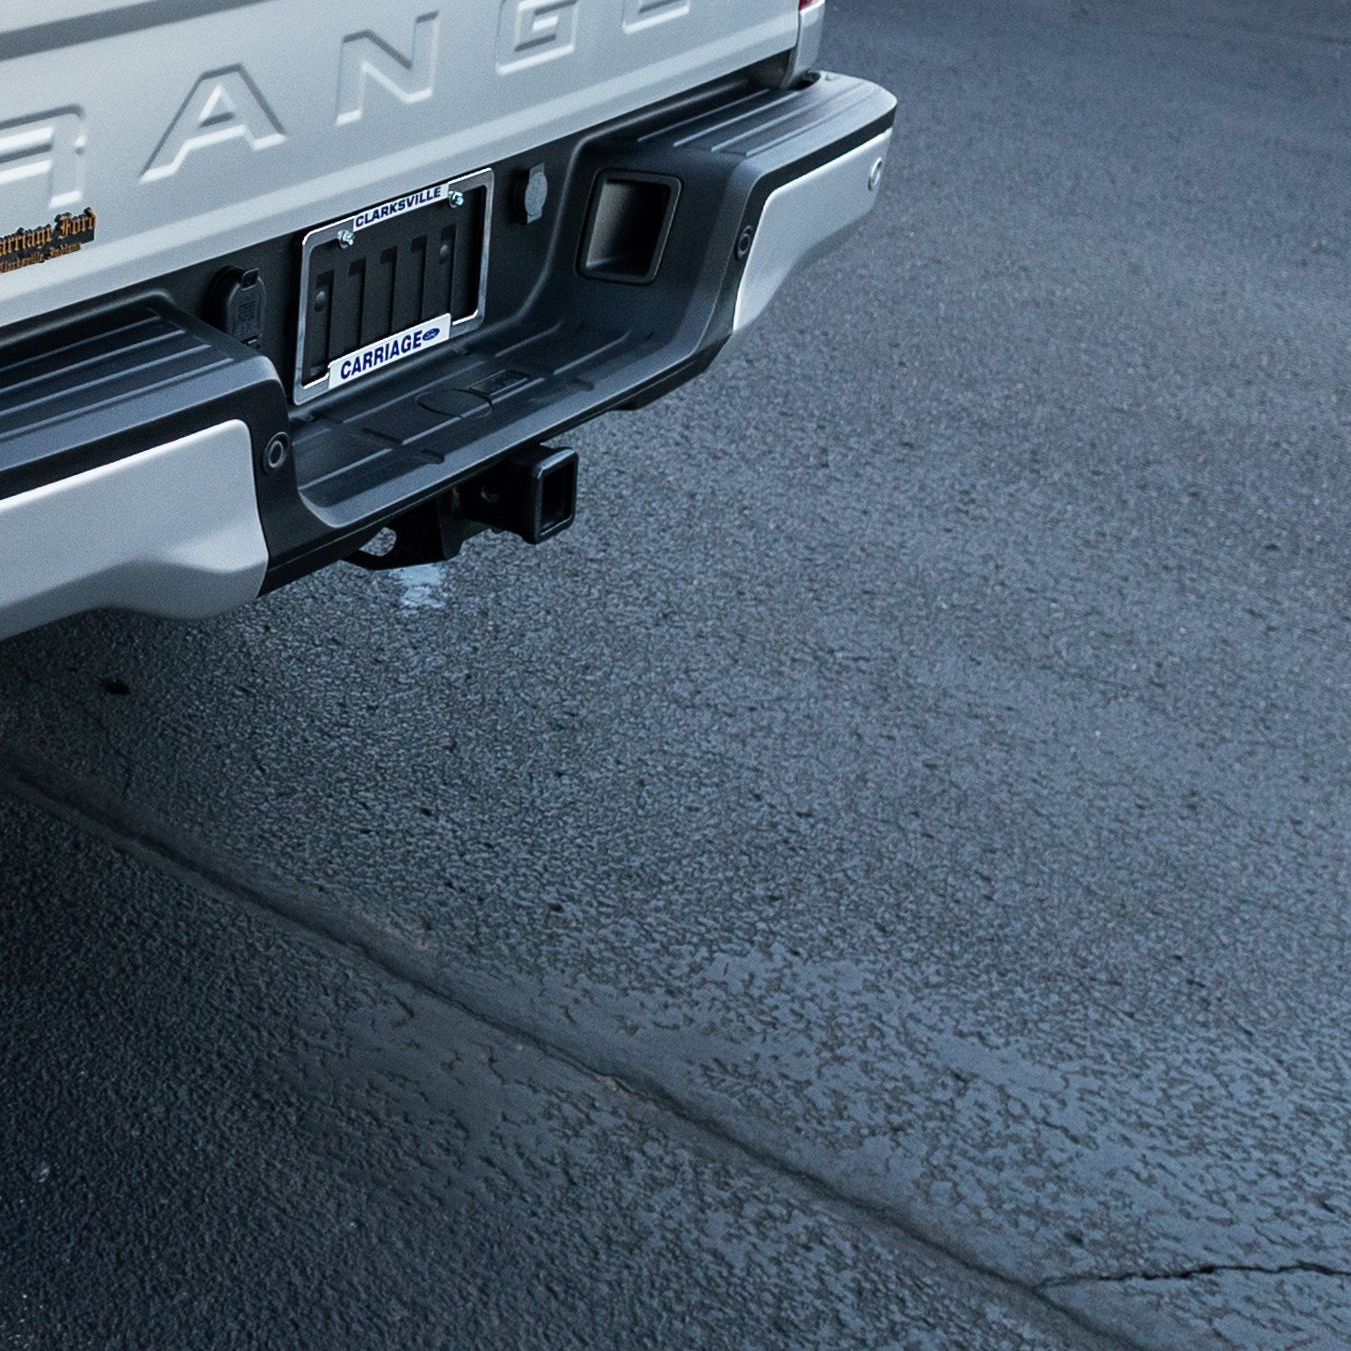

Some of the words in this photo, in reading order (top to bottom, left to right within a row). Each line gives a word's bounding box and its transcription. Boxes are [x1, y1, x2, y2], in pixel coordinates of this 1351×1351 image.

[54, 209, 97, 241] Ford
[355, 186, 442, 229] CLARKSVILLE
[340, 330, 423, 381] CARRIAGE
